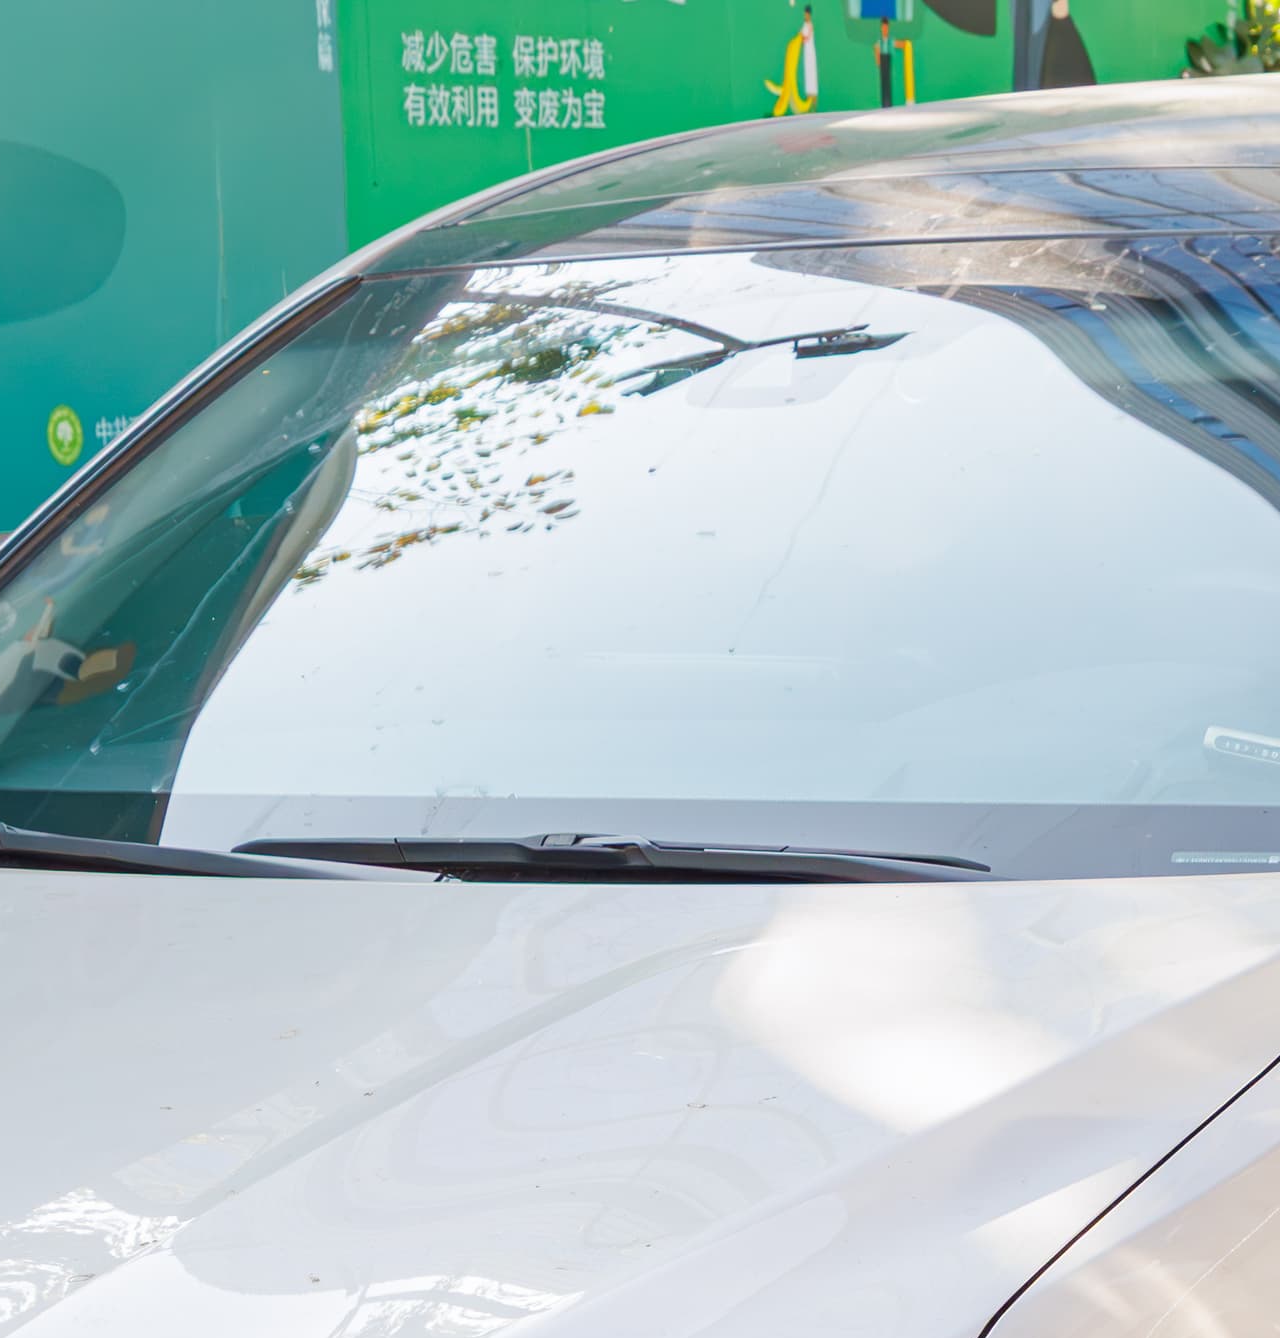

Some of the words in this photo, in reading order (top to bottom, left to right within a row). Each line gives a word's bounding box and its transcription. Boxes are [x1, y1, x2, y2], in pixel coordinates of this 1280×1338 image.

[401, 29, 497, 76] 减少危害
[512, 34, 606, 80] 保护环境
[402, 82, 499, 128] 有效利用
[513, 86, 607, 129] 变废为宝
